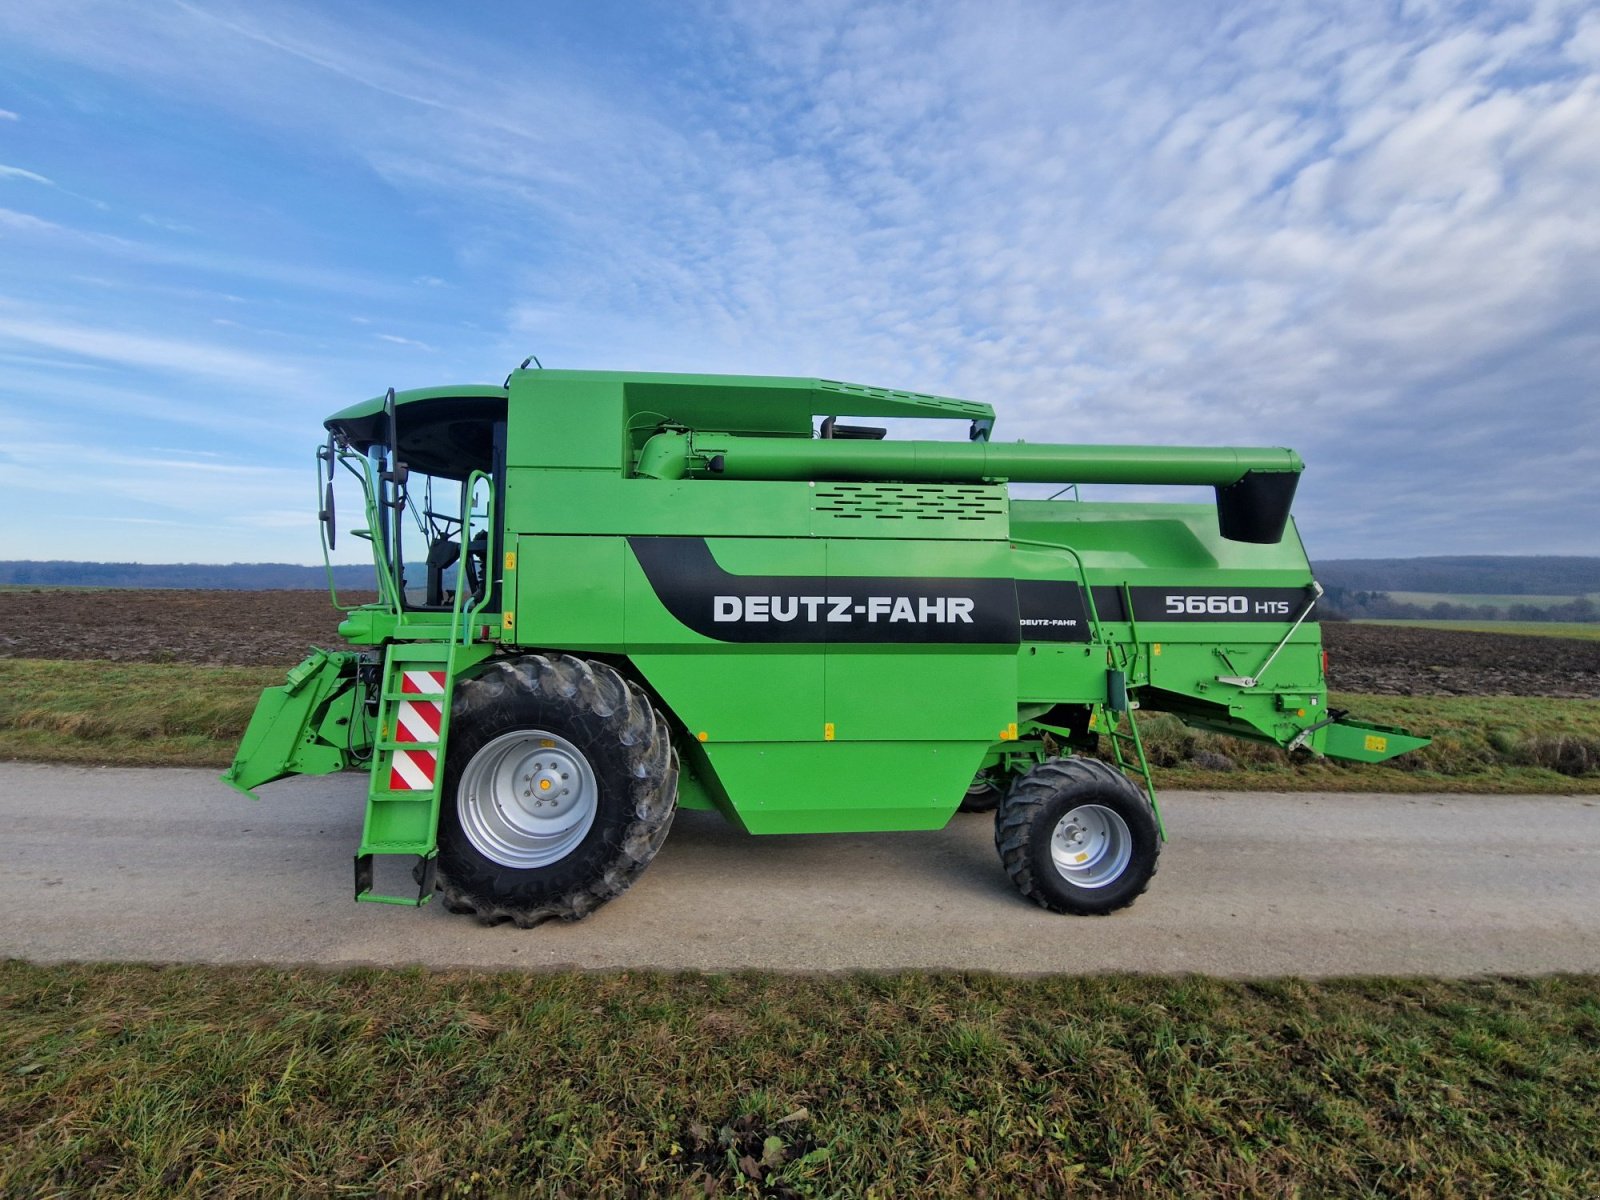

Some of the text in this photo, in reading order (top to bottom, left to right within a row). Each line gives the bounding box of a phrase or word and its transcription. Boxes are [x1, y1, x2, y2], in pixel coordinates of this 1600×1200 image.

[713, 595, 975, 623] DEUTZ-FAHR
[1165, 595, 1289, 614] 5660 HTS
